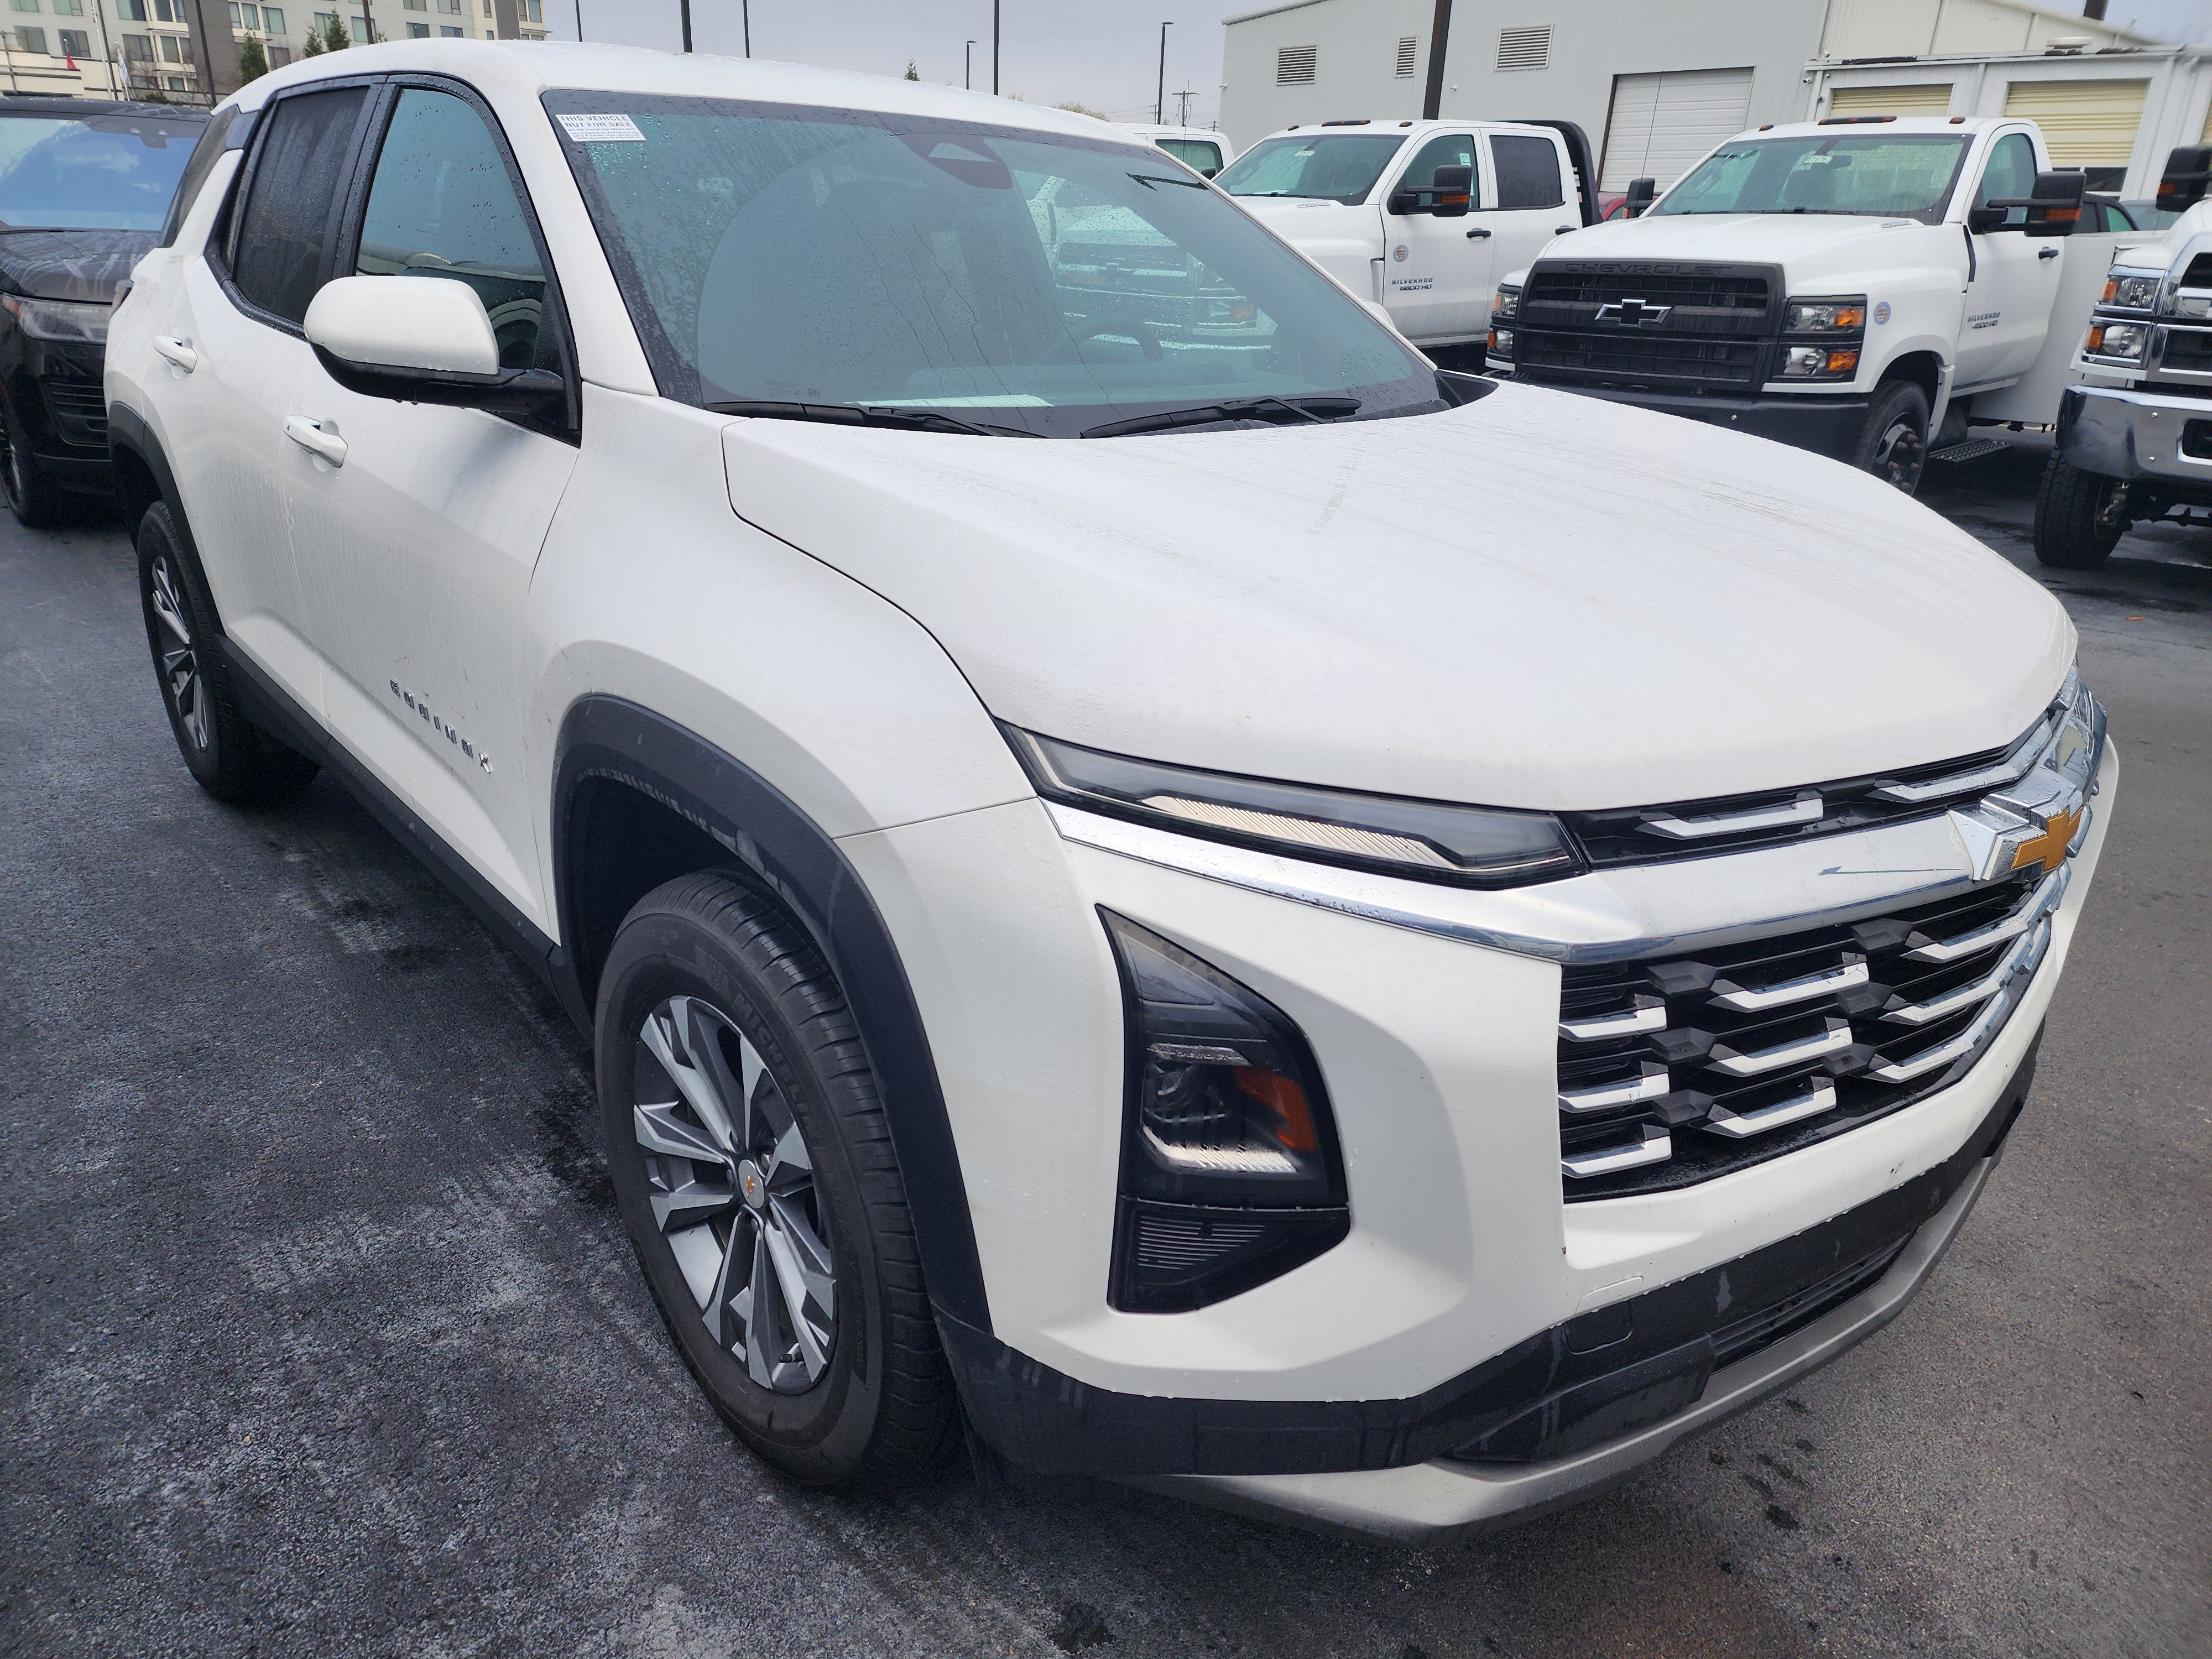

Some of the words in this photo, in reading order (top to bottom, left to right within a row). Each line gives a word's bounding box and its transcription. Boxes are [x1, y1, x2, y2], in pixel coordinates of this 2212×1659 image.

[1565, 263, 1732, 275] CHEVROLET
[1968, 311, 2001, 322] SILVERADO
[389, 679, 491, 774] EQUINOX
[732, 992, 821, 1138] MICHELIN
